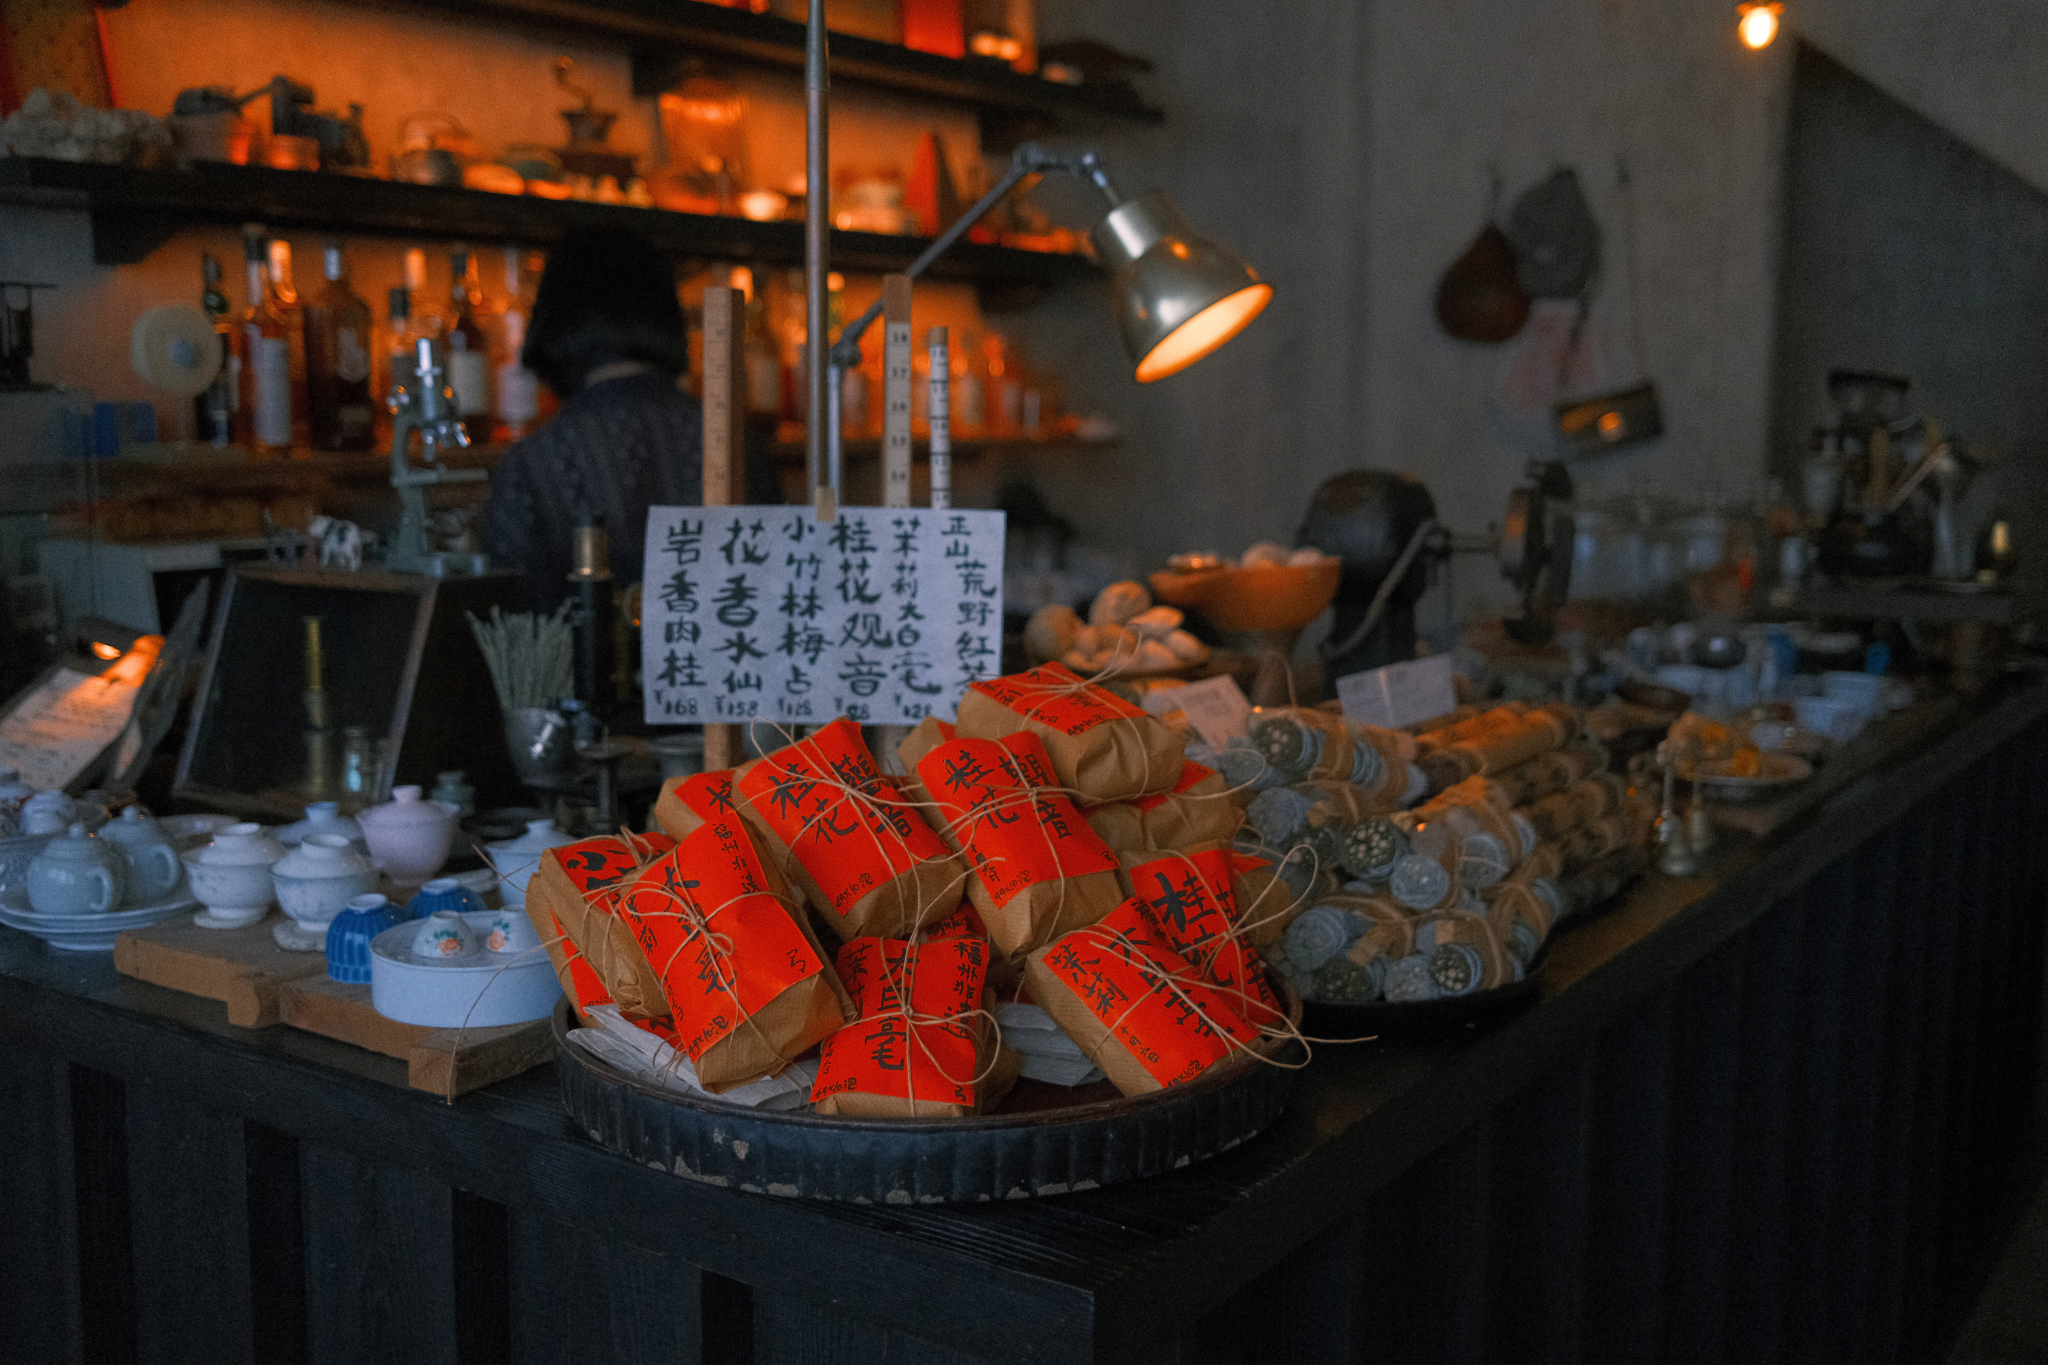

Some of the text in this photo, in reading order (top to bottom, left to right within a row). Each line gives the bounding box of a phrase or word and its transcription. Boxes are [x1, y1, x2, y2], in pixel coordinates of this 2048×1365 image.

[656, 518, 707, 688] 岩香肉桂
[712, 518, 770, 693] 花香水仙
[776, 516, 833, 694] 小竹林梅占
[829, 515, 893, 697] 桂花观音
[891, 516, 942, 695] 茉莉大白毫
[768, 762, 859, 846] 桂花
[944, 749, 1021, 830] 桂花
[1050, 942, 1130, 1019] 茉莉
